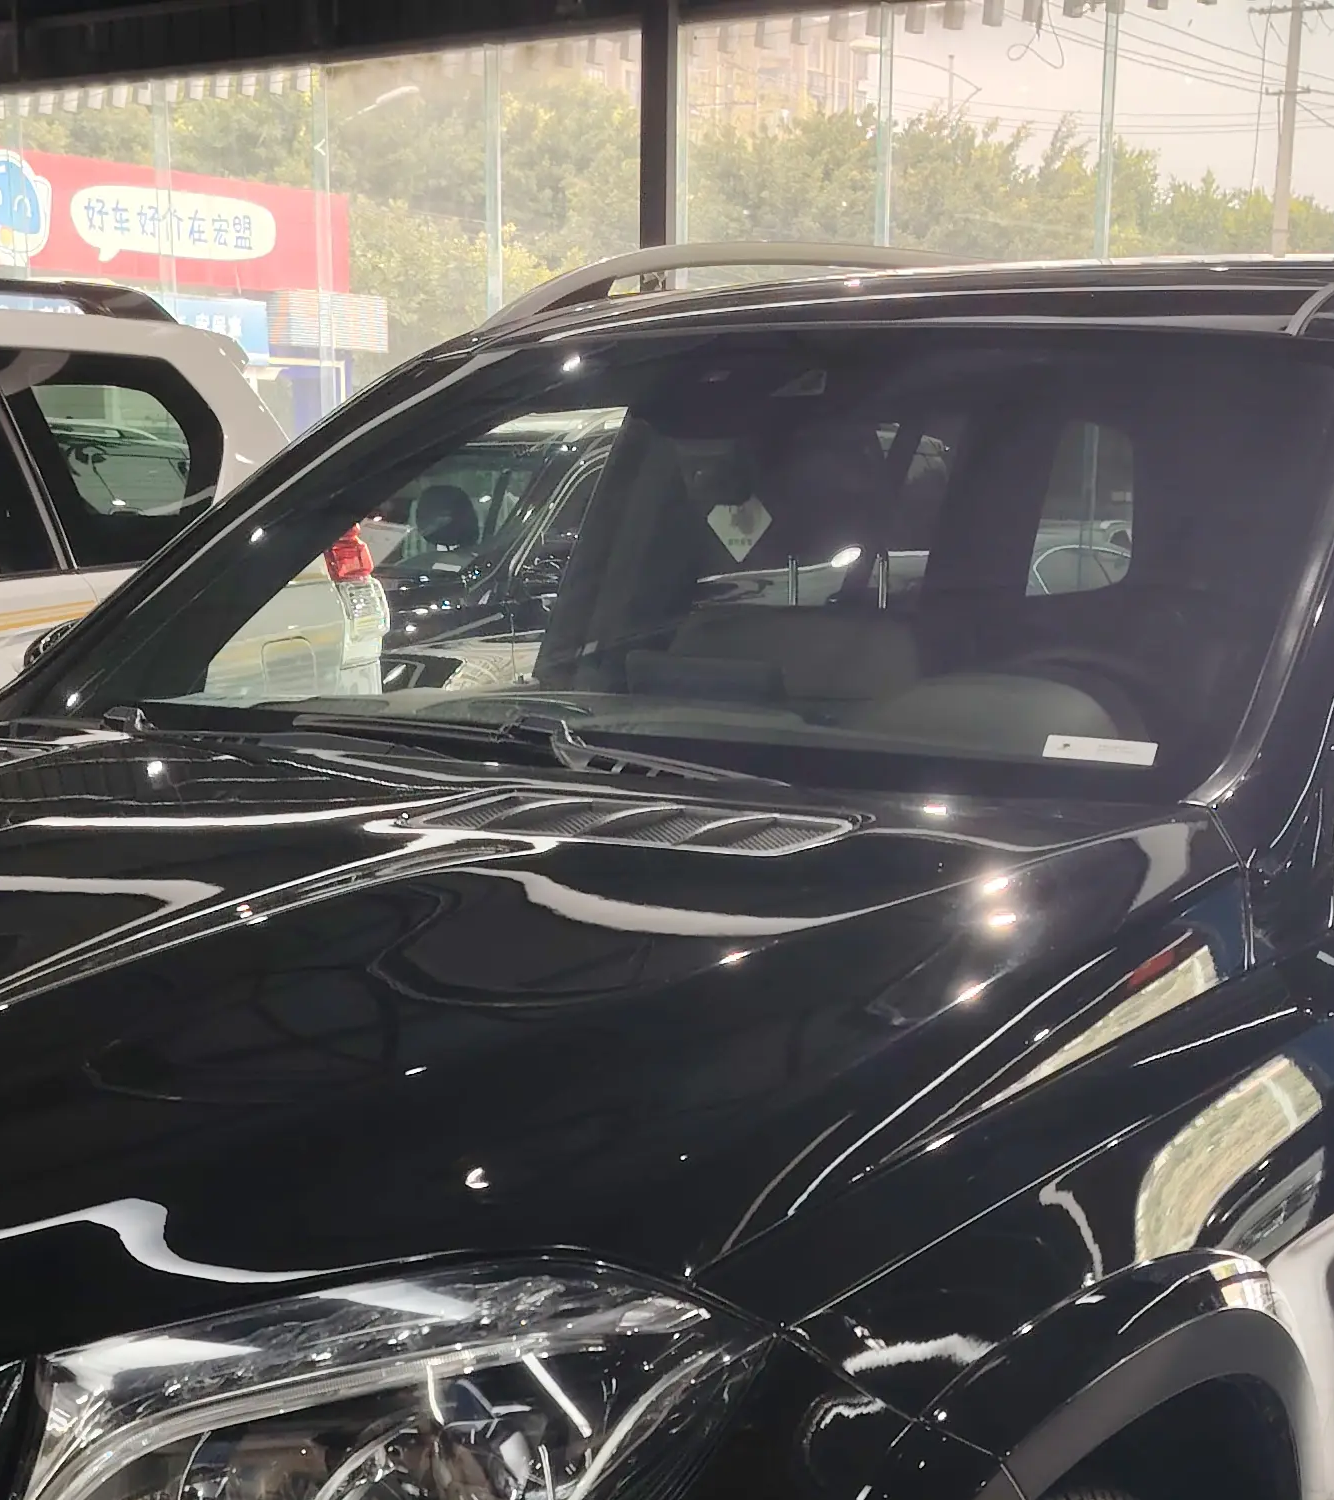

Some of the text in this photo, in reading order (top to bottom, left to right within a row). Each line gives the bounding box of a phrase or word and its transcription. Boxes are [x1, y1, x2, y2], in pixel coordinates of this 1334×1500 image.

[83, 197, 254, 251] 好车好价在宏盟
